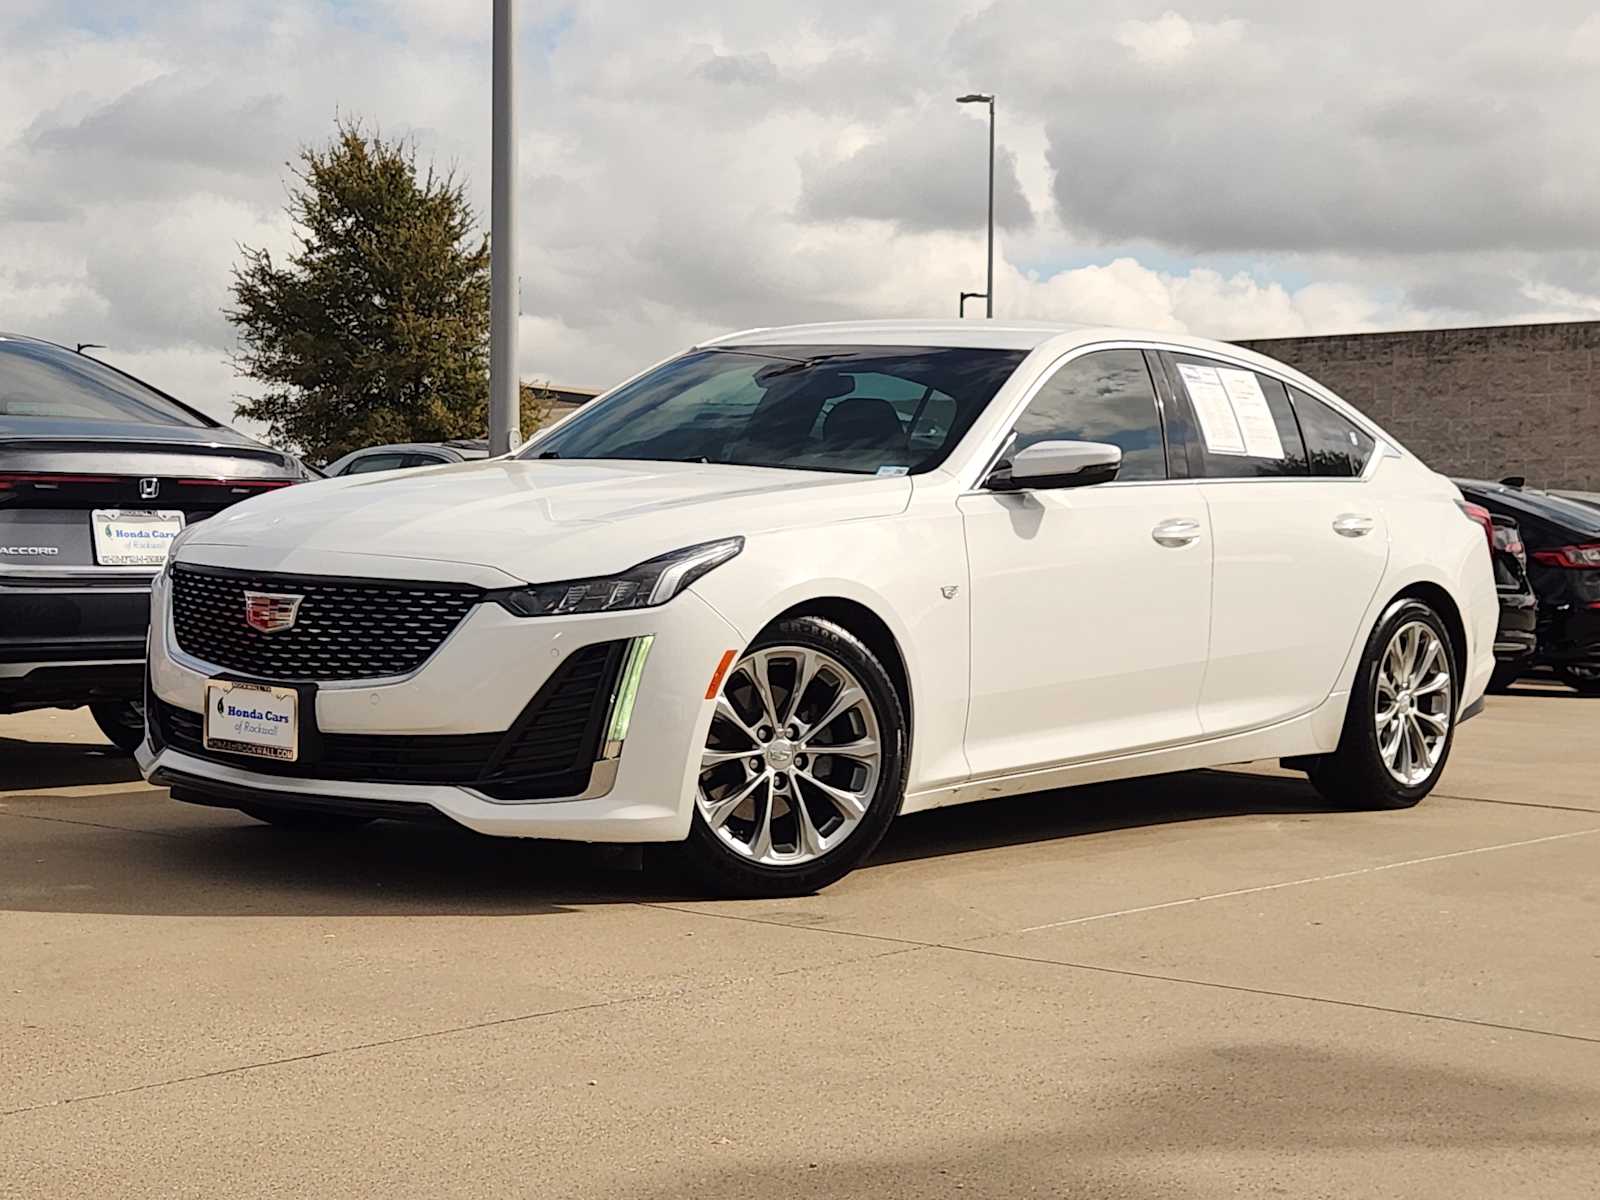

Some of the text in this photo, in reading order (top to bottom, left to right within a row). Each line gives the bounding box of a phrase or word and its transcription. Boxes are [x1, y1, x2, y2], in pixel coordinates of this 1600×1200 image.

[116, 529, 151, 538] Honda
[0, 547, 58, 556] ACCORD
[227, 706, 289, 723] Honda Cars
[234, 721, 279, 735] of Rockwall
